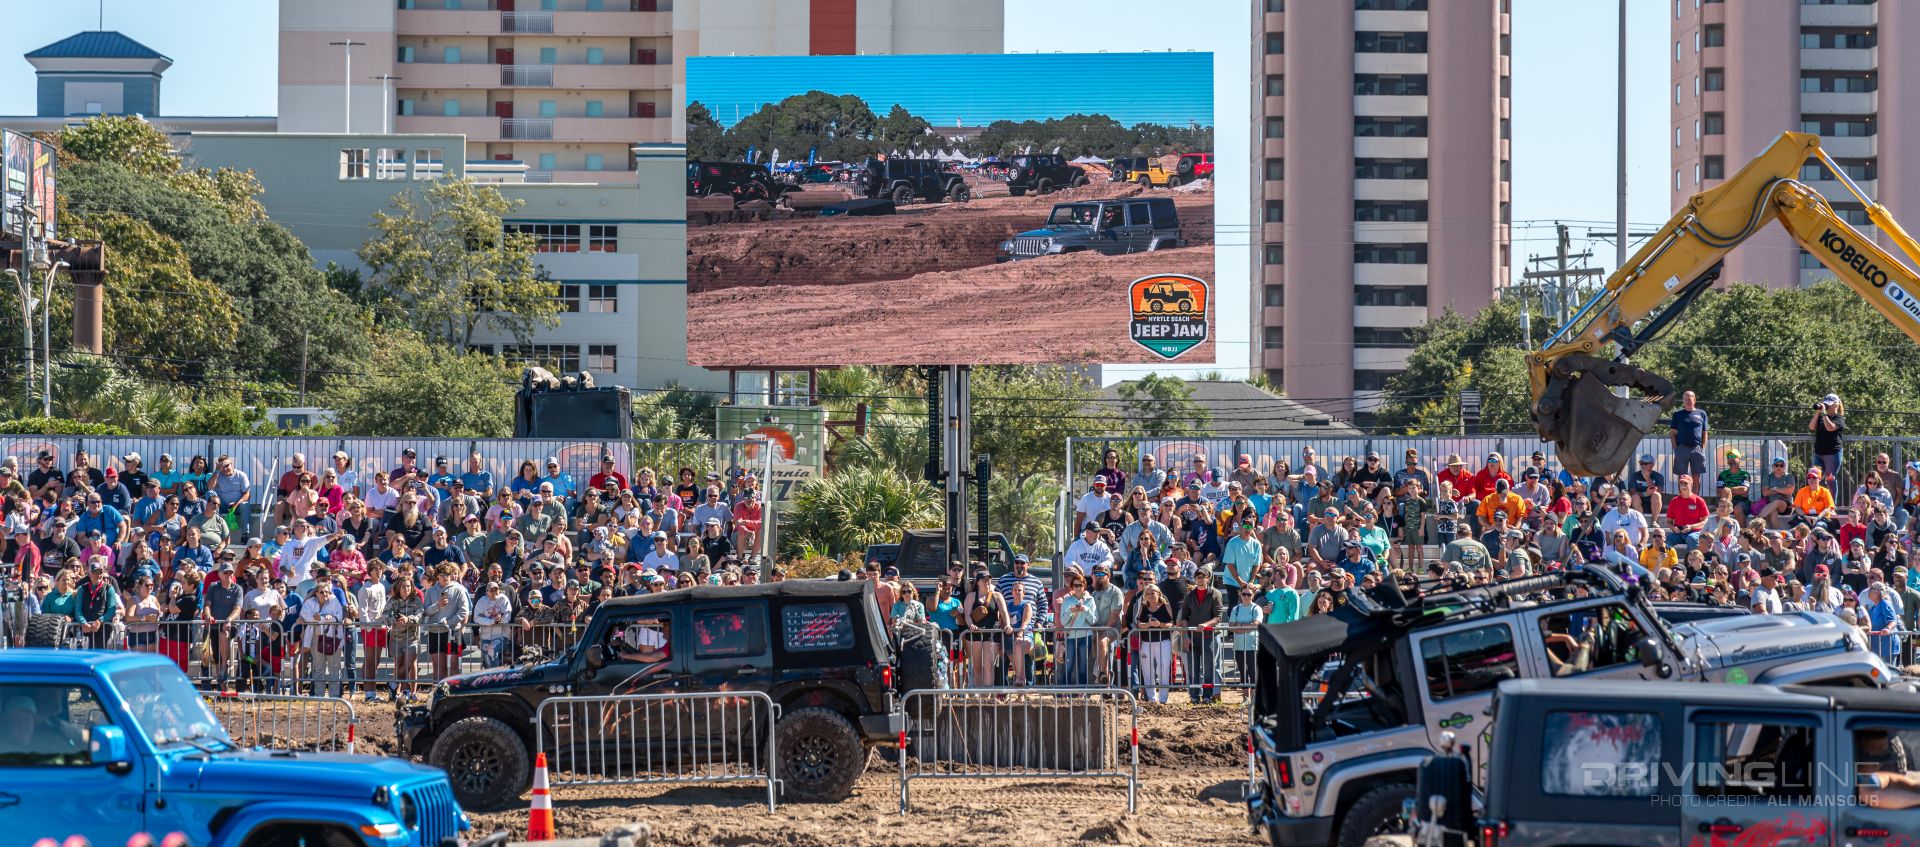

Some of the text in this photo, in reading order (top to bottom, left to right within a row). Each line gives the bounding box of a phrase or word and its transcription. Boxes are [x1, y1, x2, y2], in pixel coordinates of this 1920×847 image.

[1819, 228, 1888, 288] KOBELCO
[1135, 323, 1203, 337] JEEP JAM
[725, 465, 810, 478] Clifrnia
